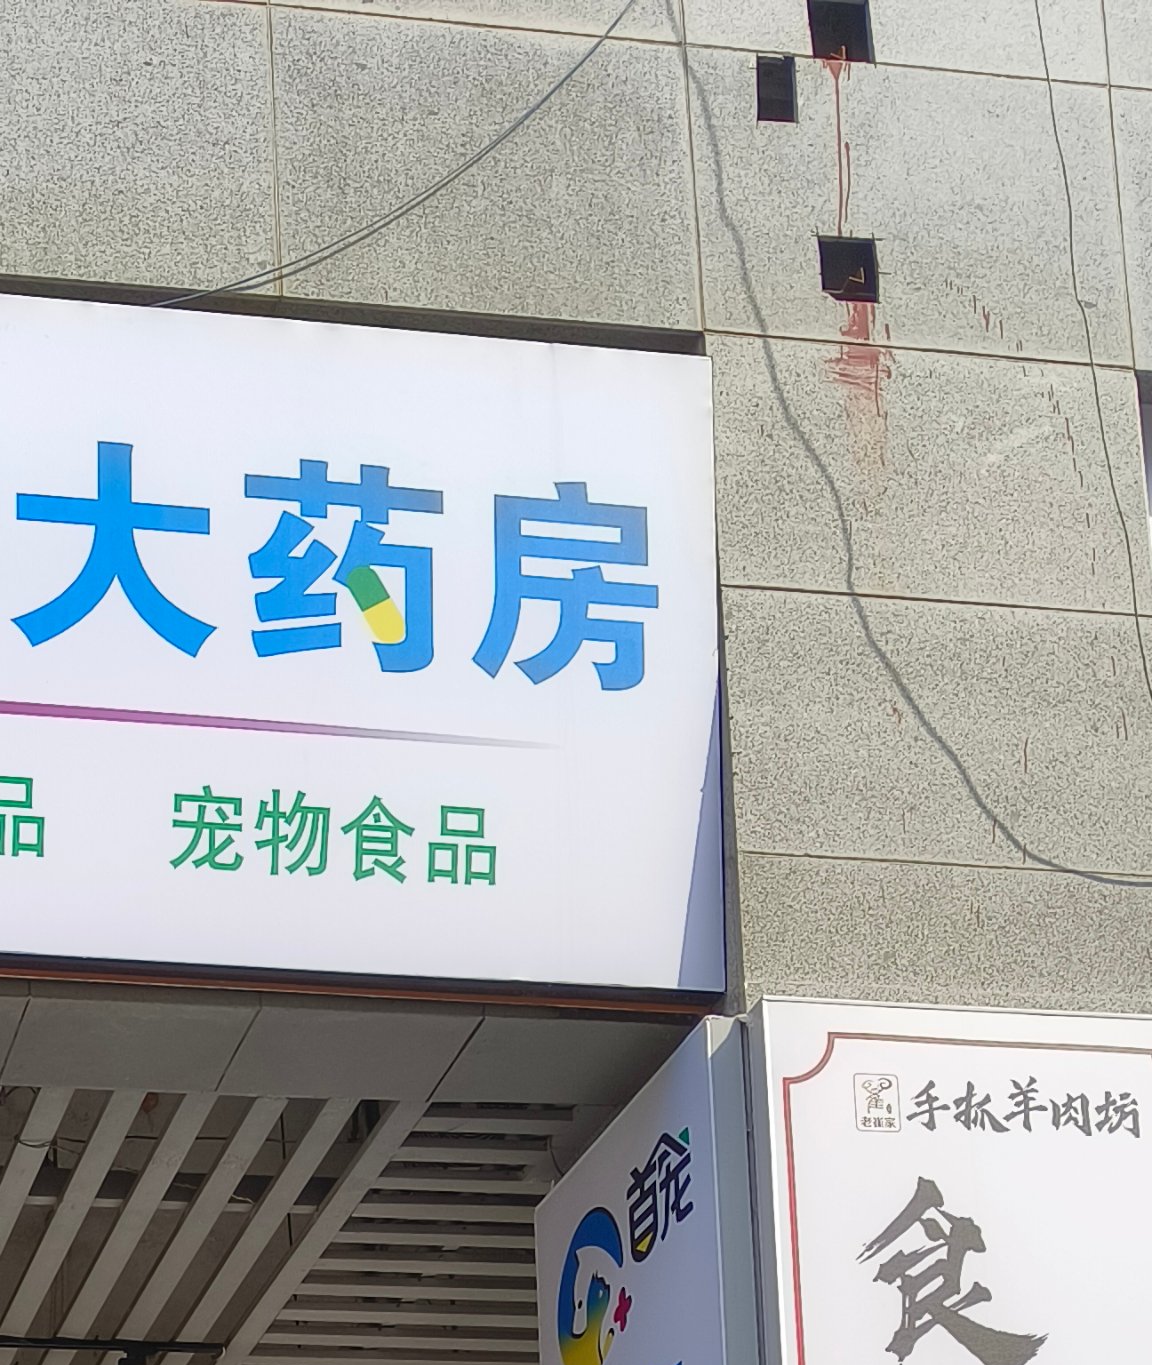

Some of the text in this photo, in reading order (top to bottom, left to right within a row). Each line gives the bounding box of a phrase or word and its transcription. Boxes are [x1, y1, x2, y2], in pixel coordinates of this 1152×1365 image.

[169, 785, 498, 885] 宠物食品
[906, 1076, 1140, 1138] 手抓羊肉坊
[626, 1127, 694, 1263] 首宠
